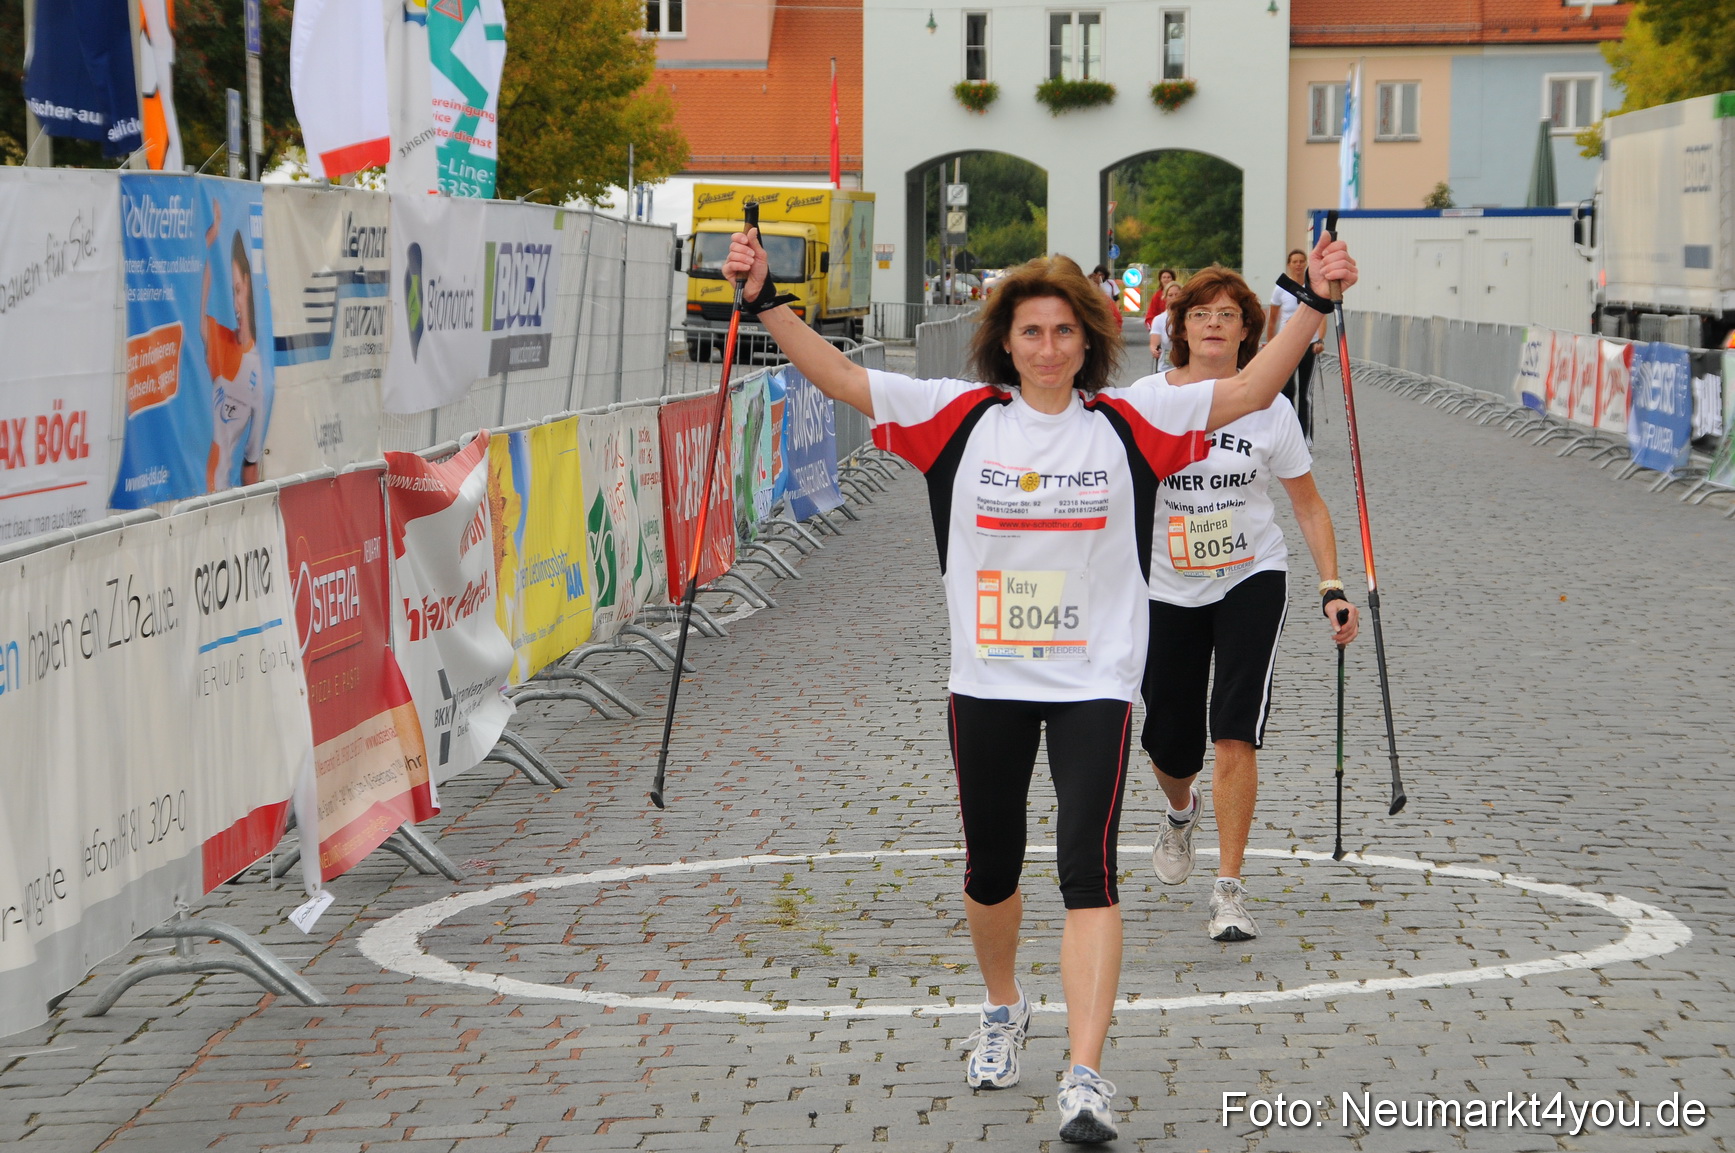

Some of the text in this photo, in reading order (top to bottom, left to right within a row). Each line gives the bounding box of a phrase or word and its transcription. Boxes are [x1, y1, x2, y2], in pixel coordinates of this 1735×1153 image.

[35, 398, 90, 466] BÖGL
[1210, 468, 1257, 490] GIRLS
[1197, 502, 1214, 514] and
[1189, 518, 1228, 534] Andrea
[1193, 532, 1248, 560] 8054
[1006, 576, 1038, 598] Katy
[1008, 605, 1080, 630] 8045
